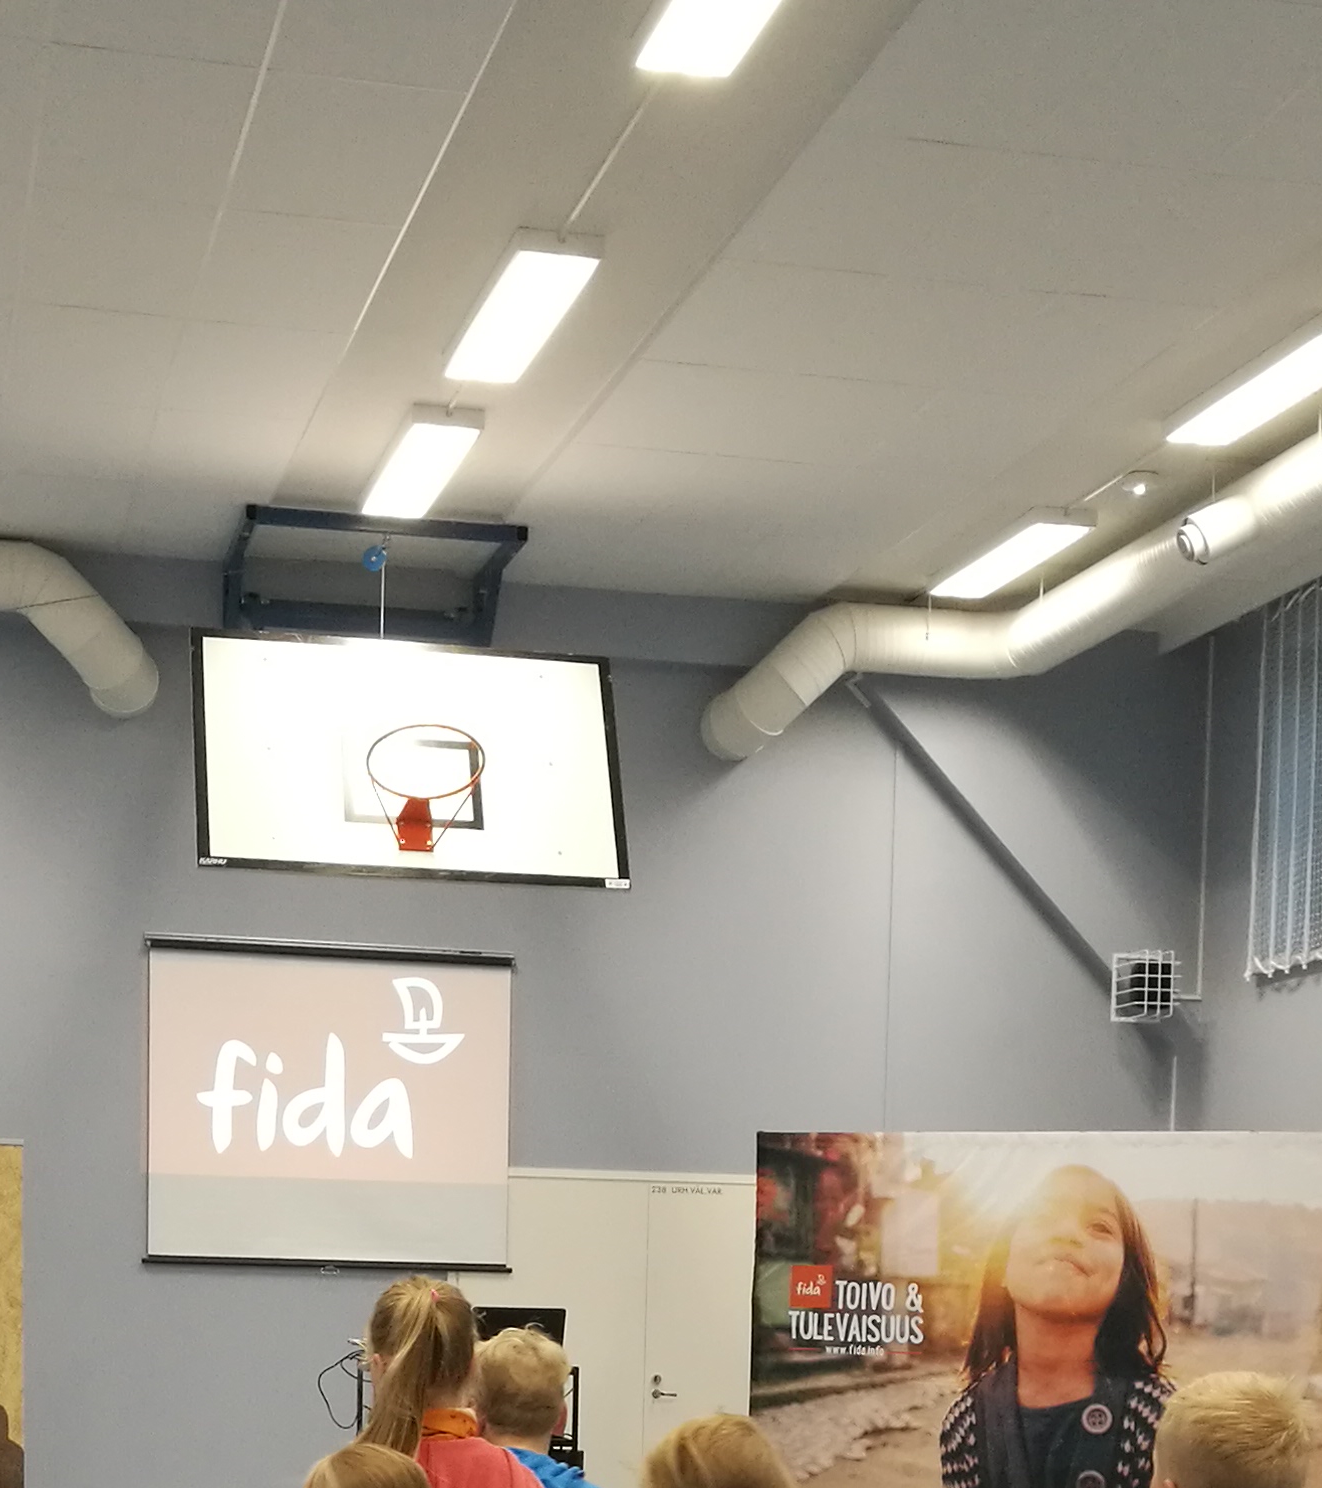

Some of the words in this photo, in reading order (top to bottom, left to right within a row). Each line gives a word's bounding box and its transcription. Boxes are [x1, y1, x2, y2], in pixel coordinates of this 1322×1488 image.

[196, 1032, 413, 1159] fida
[796, 1281, 822, 1297] fida
[835, 1280, 896, 1311] TOIVO
[905, 1282, 924, 1313] &
[788, 1310, 924, 1344] TULEVAISUUS
[825, 1344, 885, 1356] www.fida.info
